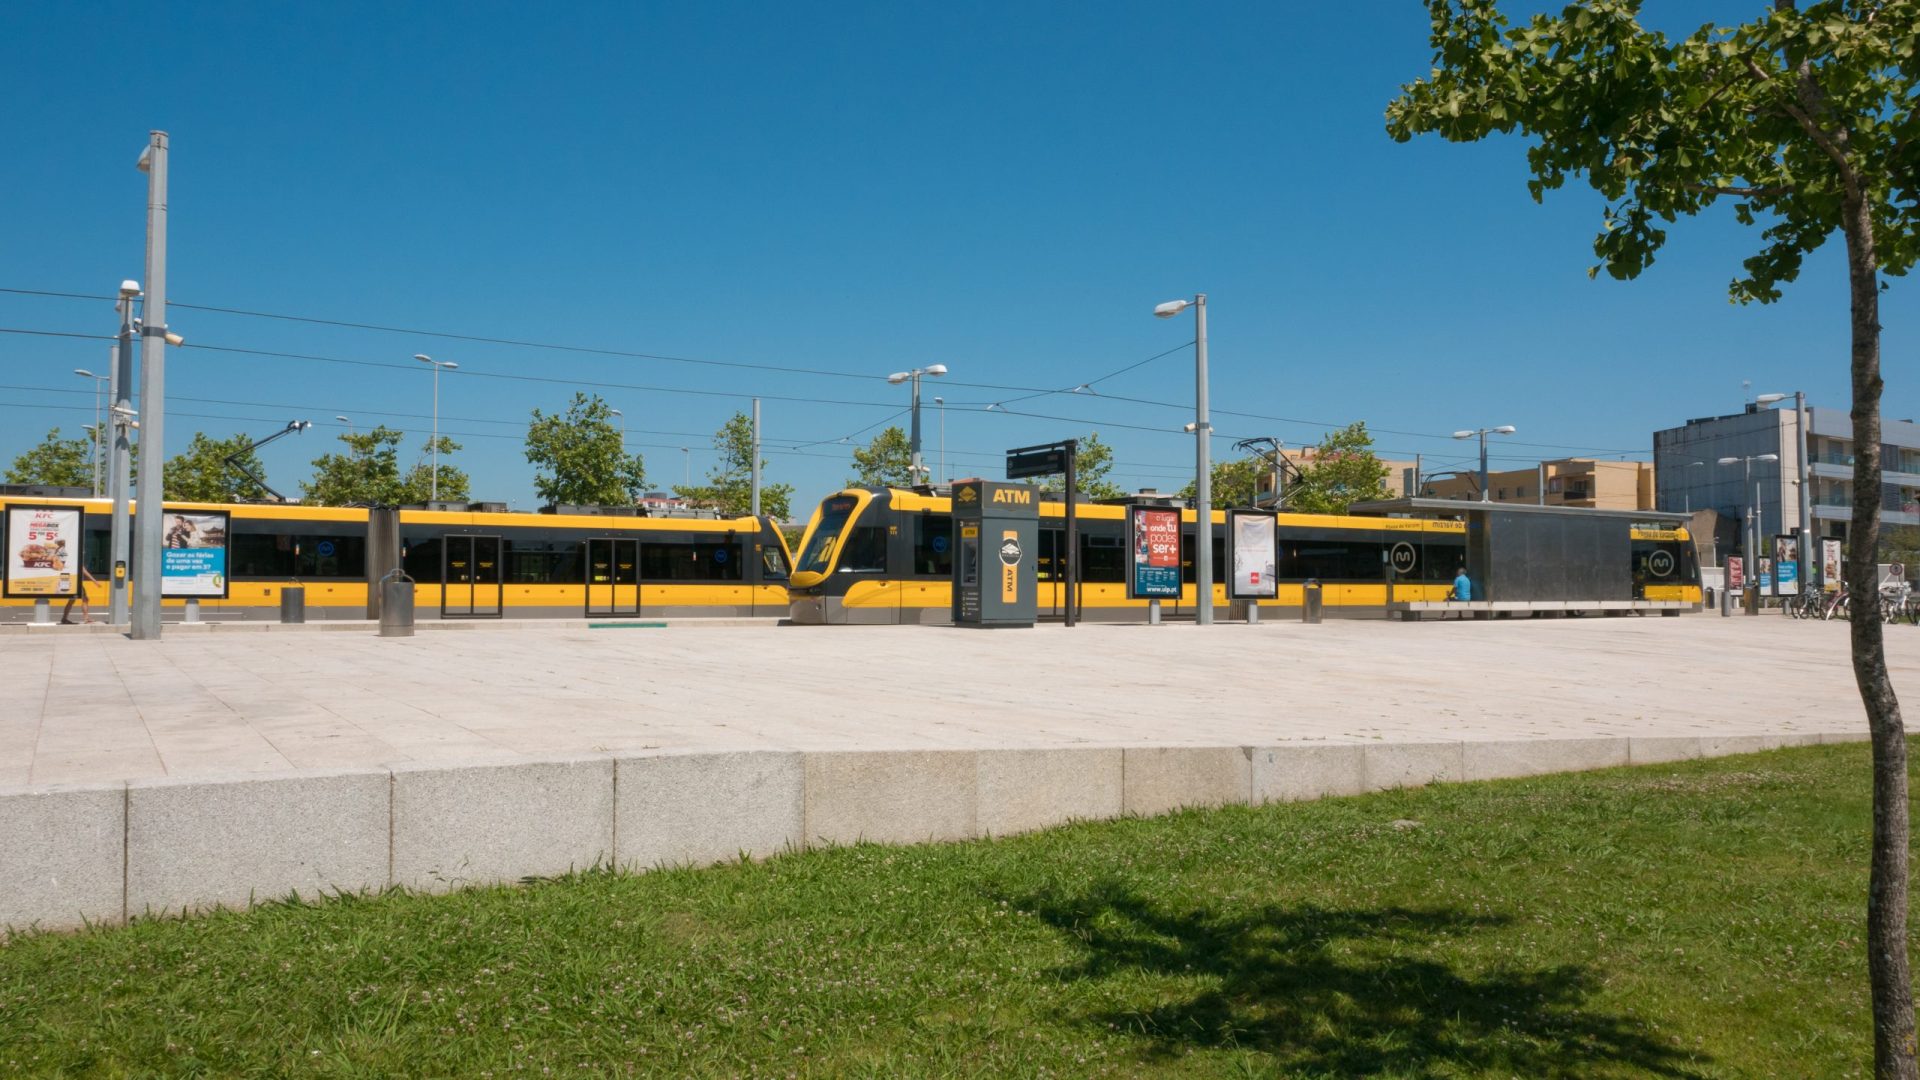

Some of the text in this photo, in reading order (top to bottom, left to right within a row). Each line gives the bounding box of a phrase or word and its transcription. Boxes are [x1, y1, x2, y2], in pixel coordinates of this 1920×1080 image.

[993, 488, 1031, 504] ATM
[1167, 520, 1177, 532] tu
[28, 532, 37, 540] 5
[1150, 532, 1177, 544] podes
[1152, 544, 1177, 554] ser+
